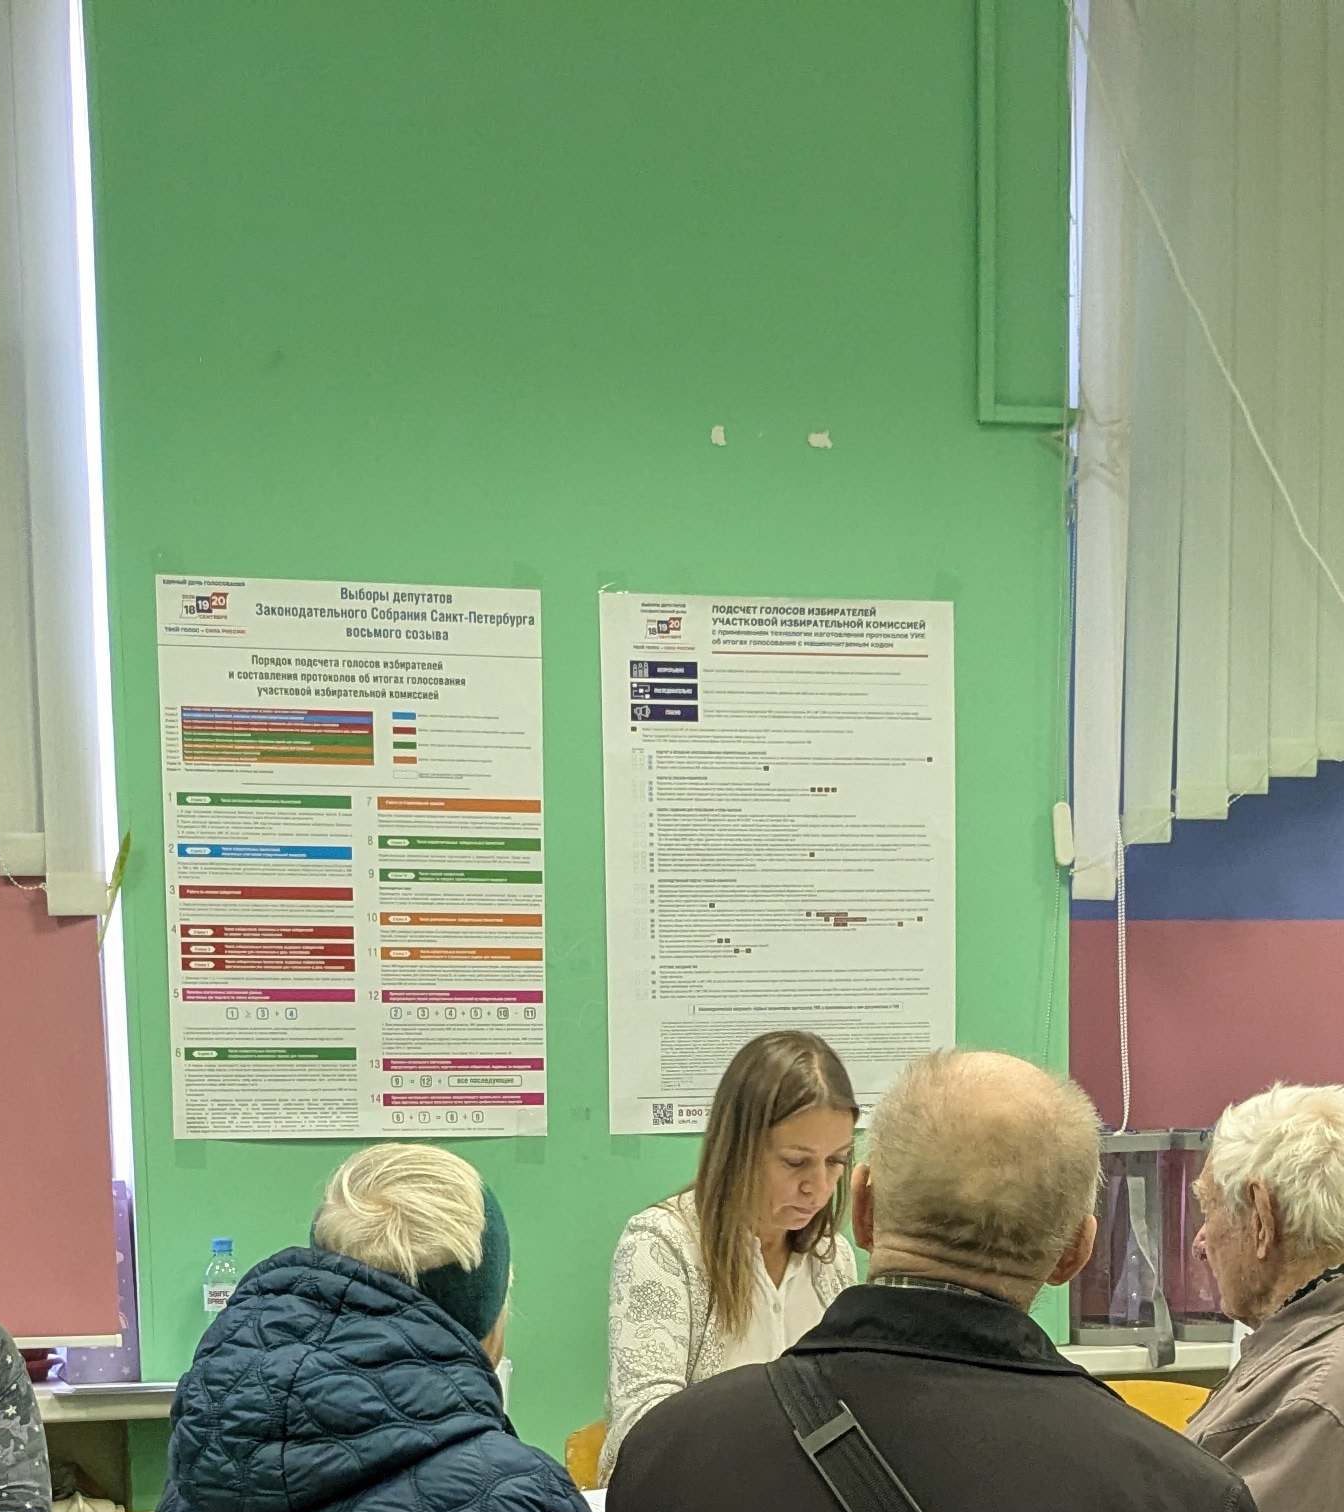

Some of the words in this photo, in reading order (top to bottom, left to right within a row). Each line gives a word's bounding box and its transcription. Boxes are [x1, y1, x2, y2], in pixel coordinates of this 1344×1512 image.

[211, 596, 226, 606] 20
[340, 587, 389, 604] Выборы
[392, 591, 454, 606] депутатов
[184, 605, 196, 615] 18
[197, 600, 210, 611] 19
[712, 604, 758, 616] ПОДСЧЕТ
[760, 606, 806, 616] ГОЛОСОВ
[808, 606, 876, 617] ИЗБИРАТЕЛЕЙ
[255, 603, 368, 620] Законодательного
[371, 607, 427, 622] Собрания
[430, 610, 535, 628] Санкт-Петербурга
[658, 623, 668, 632] 19
[668, 620, 680, 628] 20
[712, 617, 778, 627] УЧАСТКОВОЙ
[780, 618, 864, 629] ИЗБИРАТЕЛЬНОЙ
[866, 620, 926, 630] КОМИССИЕЙ
[346, 626, 402, 639] восьмого
[406, 630, 449, 640] созыва
[648, 628, 657, 636] 18
[251, 654, 292, 668] Порядок
[295, 657, 340, 668] подсчета
[342, 659, 380, 670] голосов
[383, 659, 444, 672] избирателей
[237, 671, 298, 681] составления
[301, 673, 356, 684] протоколов
[358, 674, 370, 684] об
[373, 676, 404, 685] итогах
[406, 677, 466, 687] голосования
[257, 686, 312, 697] участковой
[314, 688, 386, 699] избирательной
[390, 690, 440, 700] комиссией
[168, 792, 172, 802] 1
[366, 796, 372, 806] 7
[368, 836, 374, 846] 8
[168, 844, 174, 854] 2
[368, 869, 374, 878] 9
[170, 885, 176, 895] 3
[366, 912, 378, 922] 10
[170, 924, 177, 934] 4
[368, 948, 378, 957] 11
[173, 988, 180, 998] 5
[368, 990, 380, 1000] 12
[176, 1048, 182, 1058] 6
[370, 1060, 380, 1069] 13
[370, 1094, 381, 1104] 14
